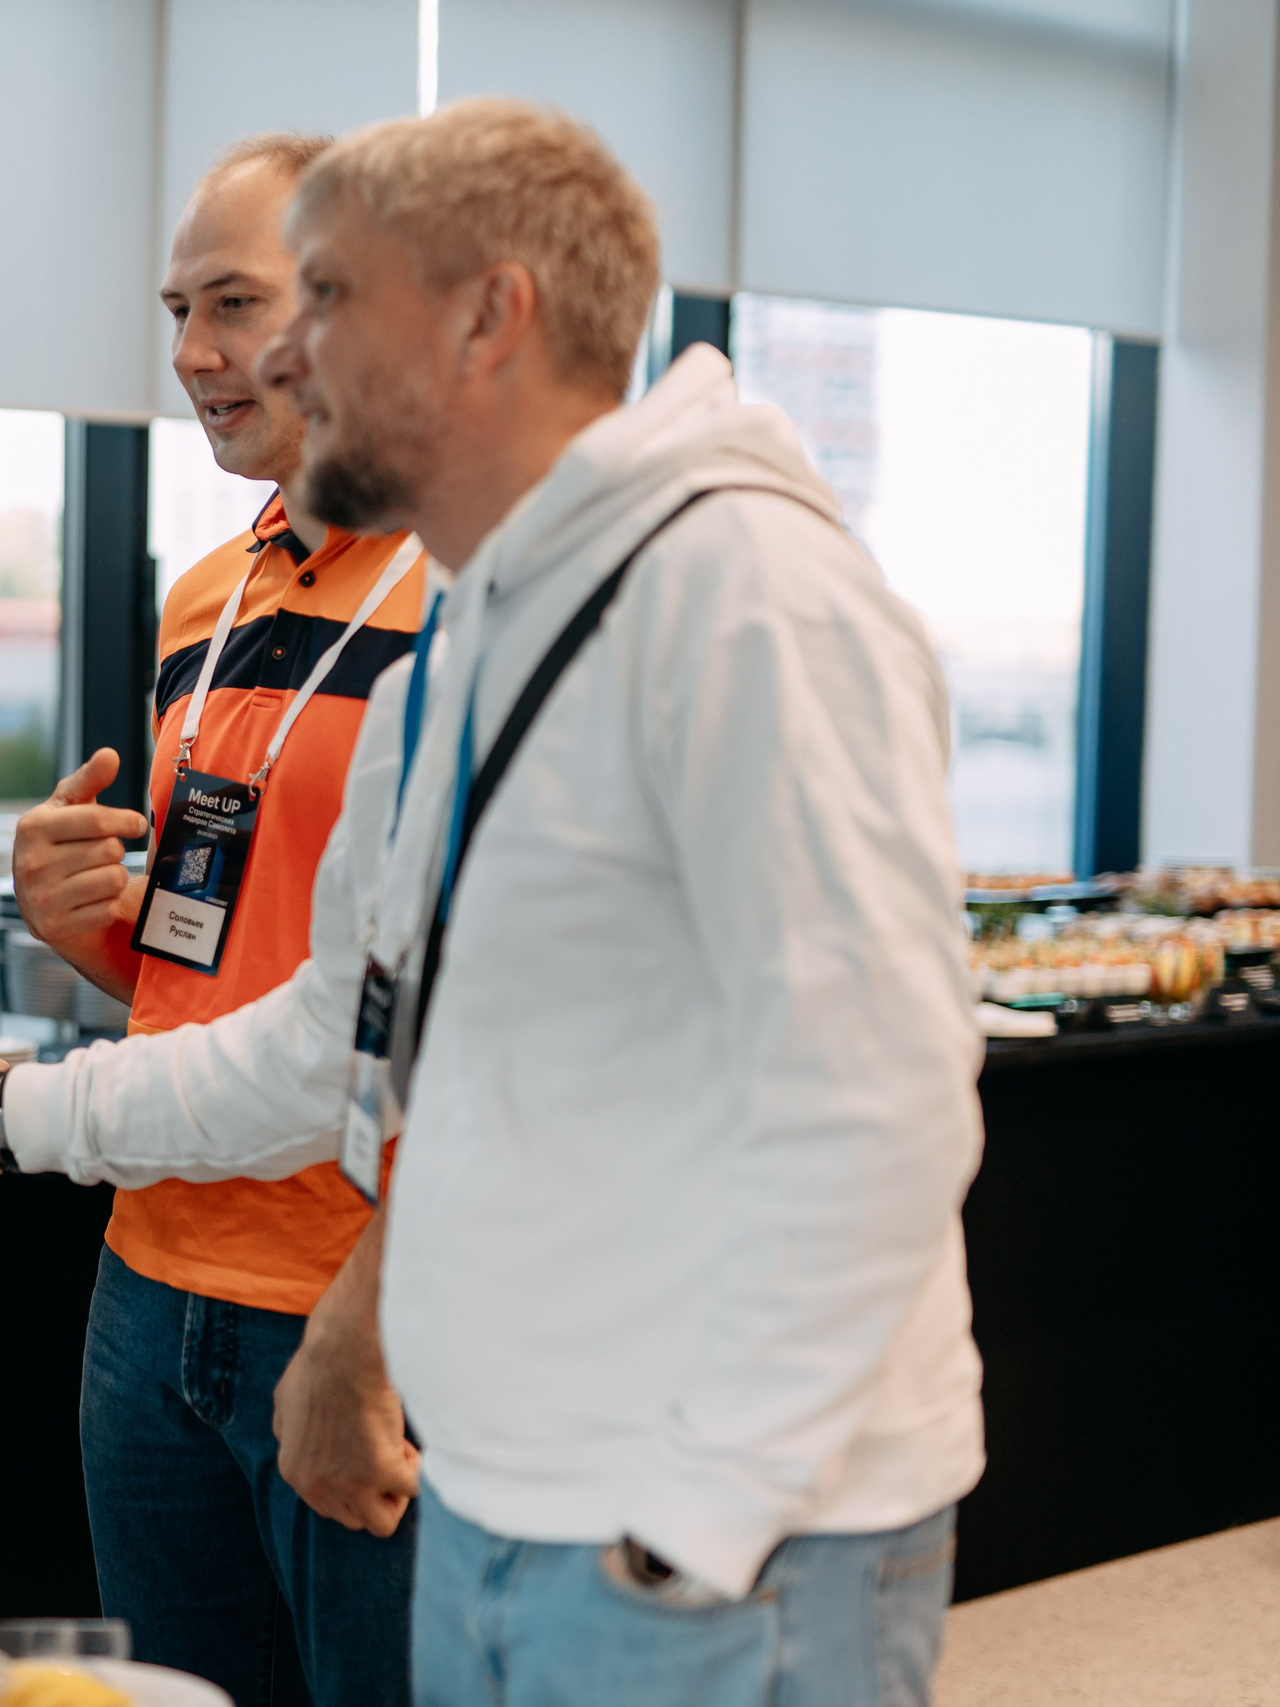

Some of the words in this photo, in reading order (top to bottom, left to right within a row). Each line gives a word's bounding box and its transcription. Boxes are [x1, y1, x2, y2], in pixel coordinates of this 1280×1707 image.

[188, 787, 219, 809] Meet
[221, 797, 241, 814] UP
[183, 814, 208, 828] лидеров
[208, 820, 237, 834] Самолета
[188, 806, 235, 825] Стратегических
[168, 911, 205, 929] Соловьев
[169, 925, 197, 941] Руслан
